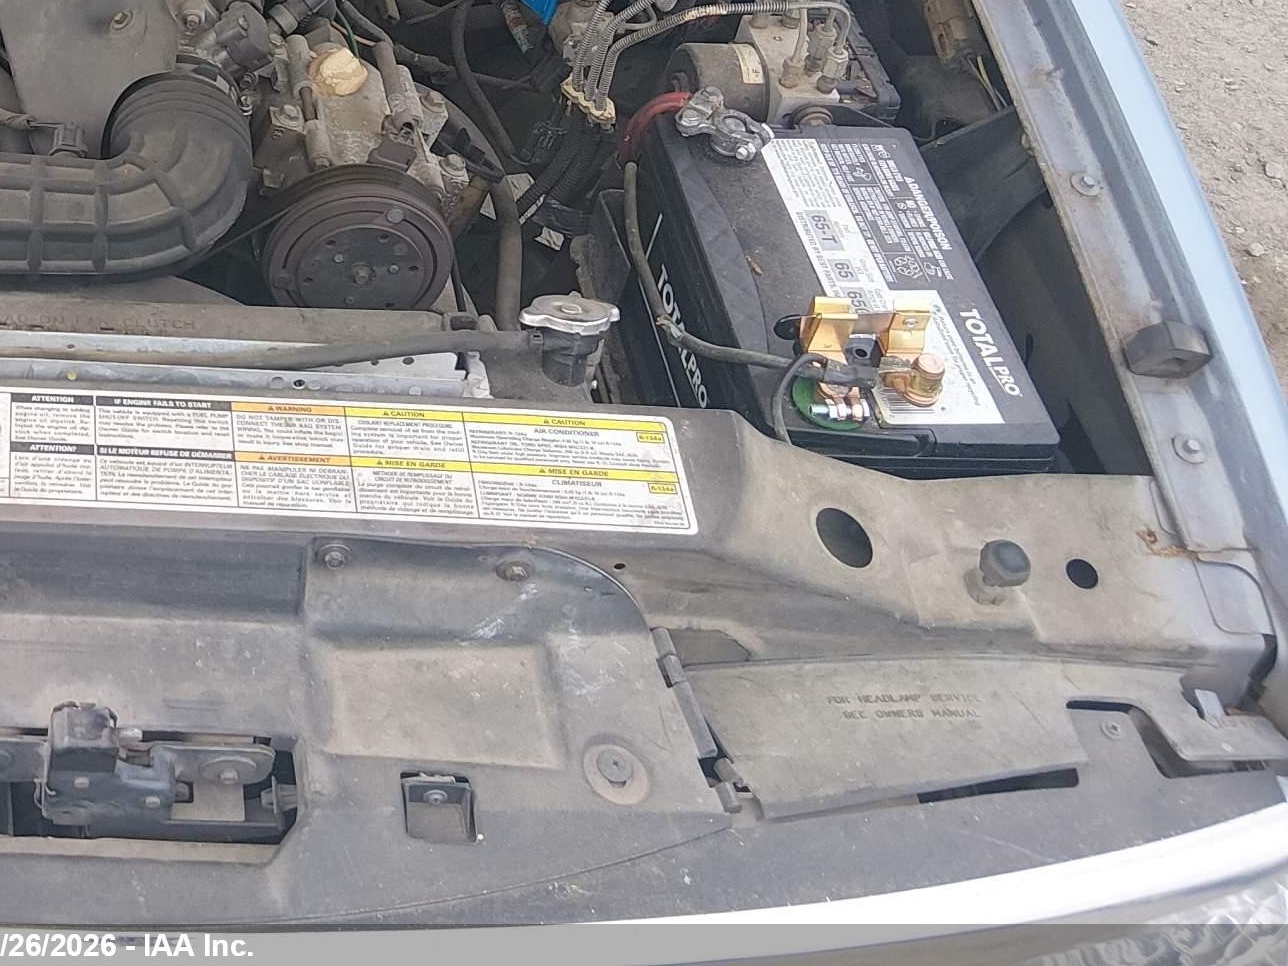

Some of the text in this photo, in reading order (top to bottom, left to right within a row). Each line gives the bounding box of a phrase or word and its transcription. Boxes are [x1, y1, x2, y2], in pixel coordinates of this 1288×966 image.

[907, 183, 952, 249] DANGER/POISON
[808, 214, 838, 243] 65-T
[832, 262, 855, 278] 65
[960, 309, 1021, 396] TOTALPRO
[153, 399, 174, 407] FAILS
[187, 401, 212, 409] START
[550, 418, 586, 426] CAUTION
[547, 428, 600, 437] CONDITIONER
[117, 447, 149, 455] MOTEUR
[150, 449, 178, 457] REFUSE
[179, 450, 190, 458] DE
[266, 455, 330, 463] AVERTISSEMENT
[547, 467, 567, 475] MISE
[581, 469, 609, 477] GARDE
[551, 479, 602, 487] CLIMATISEUR
[828, 693, 983, 705] FOR HEADLAMP SERVICE
[842, 709, 981, 719] SEE OWNERS MANUAL
